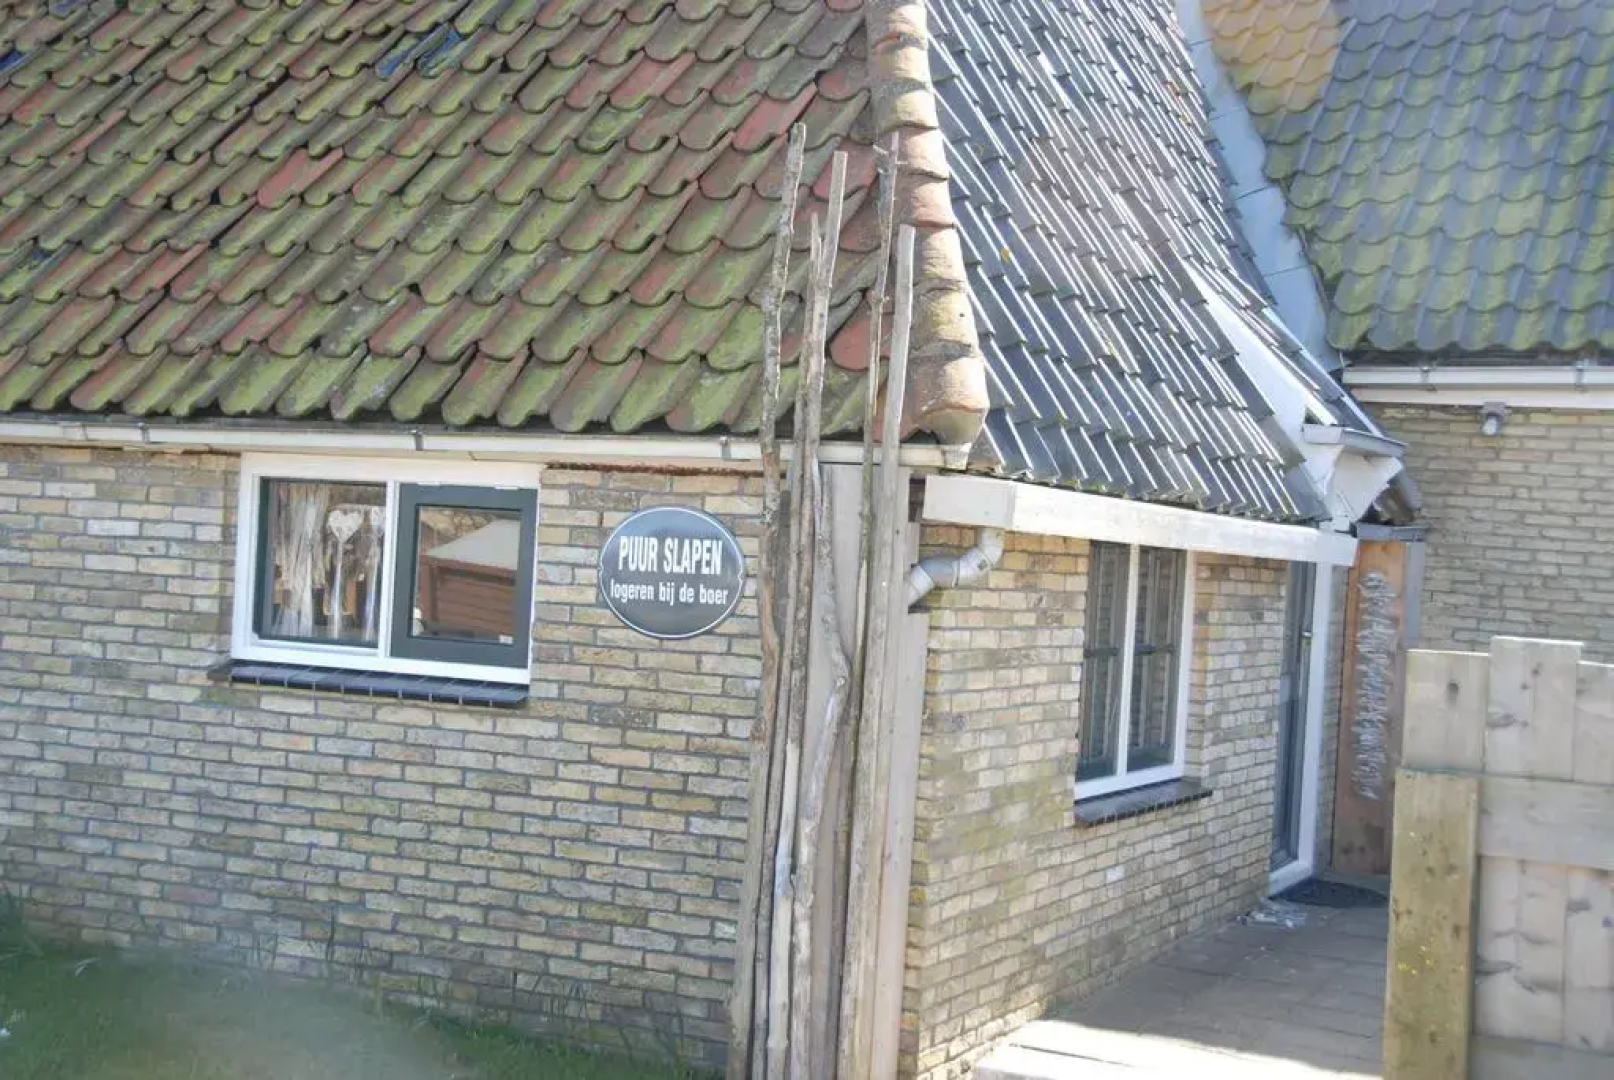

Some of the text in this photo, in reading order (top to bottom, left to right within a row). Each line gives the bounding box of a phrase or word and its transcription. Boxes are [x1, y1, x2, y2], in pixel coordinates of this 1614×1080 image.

[618, 535, 723, 575] PUUR SLAPEN
[610, 578, 729, 606] logeren bij de boer
